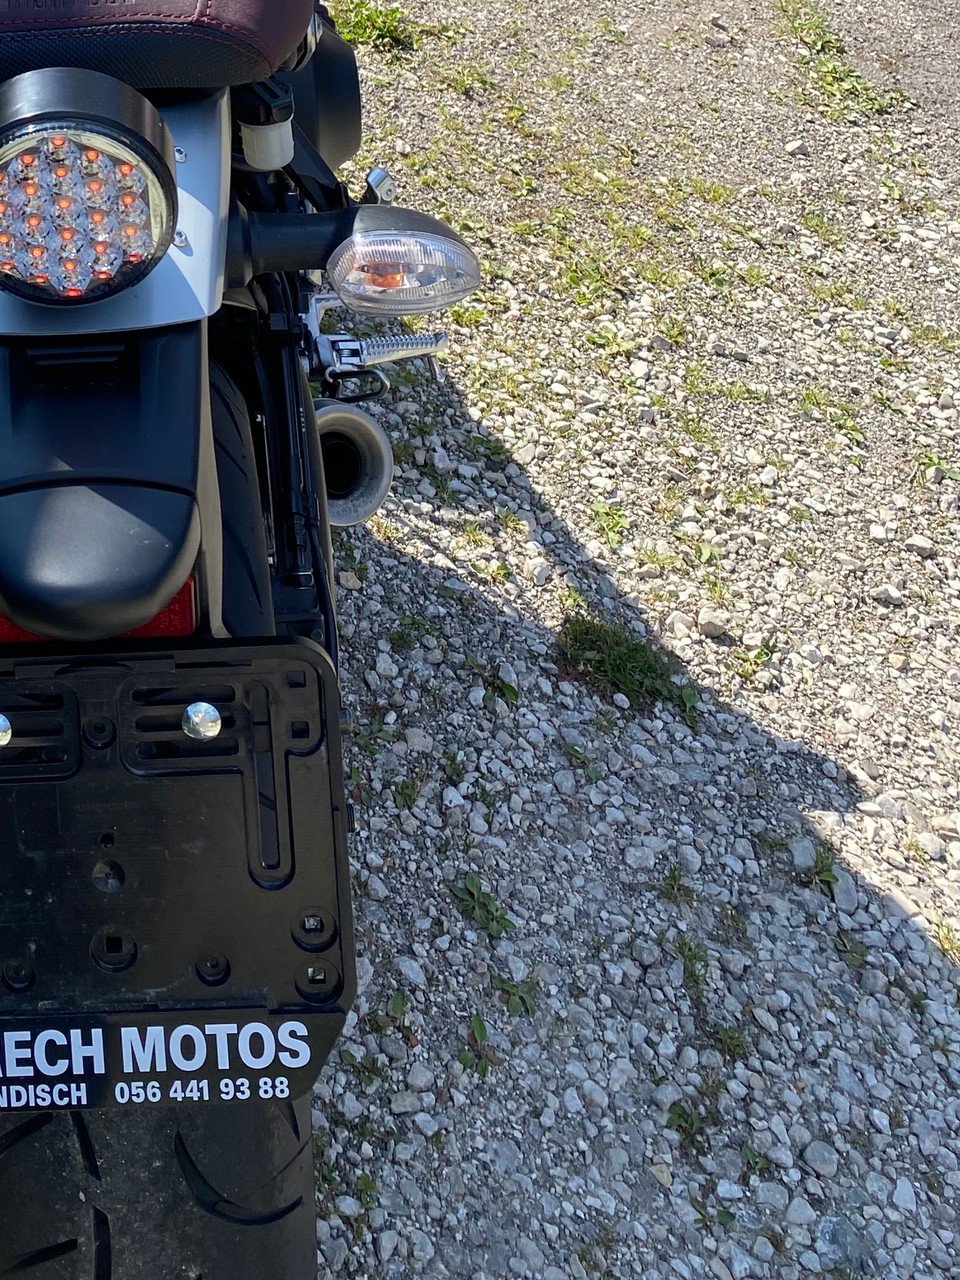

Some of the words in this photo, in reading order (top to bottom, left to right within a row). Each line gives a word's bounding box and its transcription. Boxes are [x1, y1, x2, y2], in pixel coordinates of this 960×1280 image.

[120, 1021, 311, 1073] MOTOS
[114, 1080, 161, 1104] 056
[169, 1079, 210, 1102] 441
[219, 1077, 251, 1101] 93
[258, 1076, 290, 1099] 88
